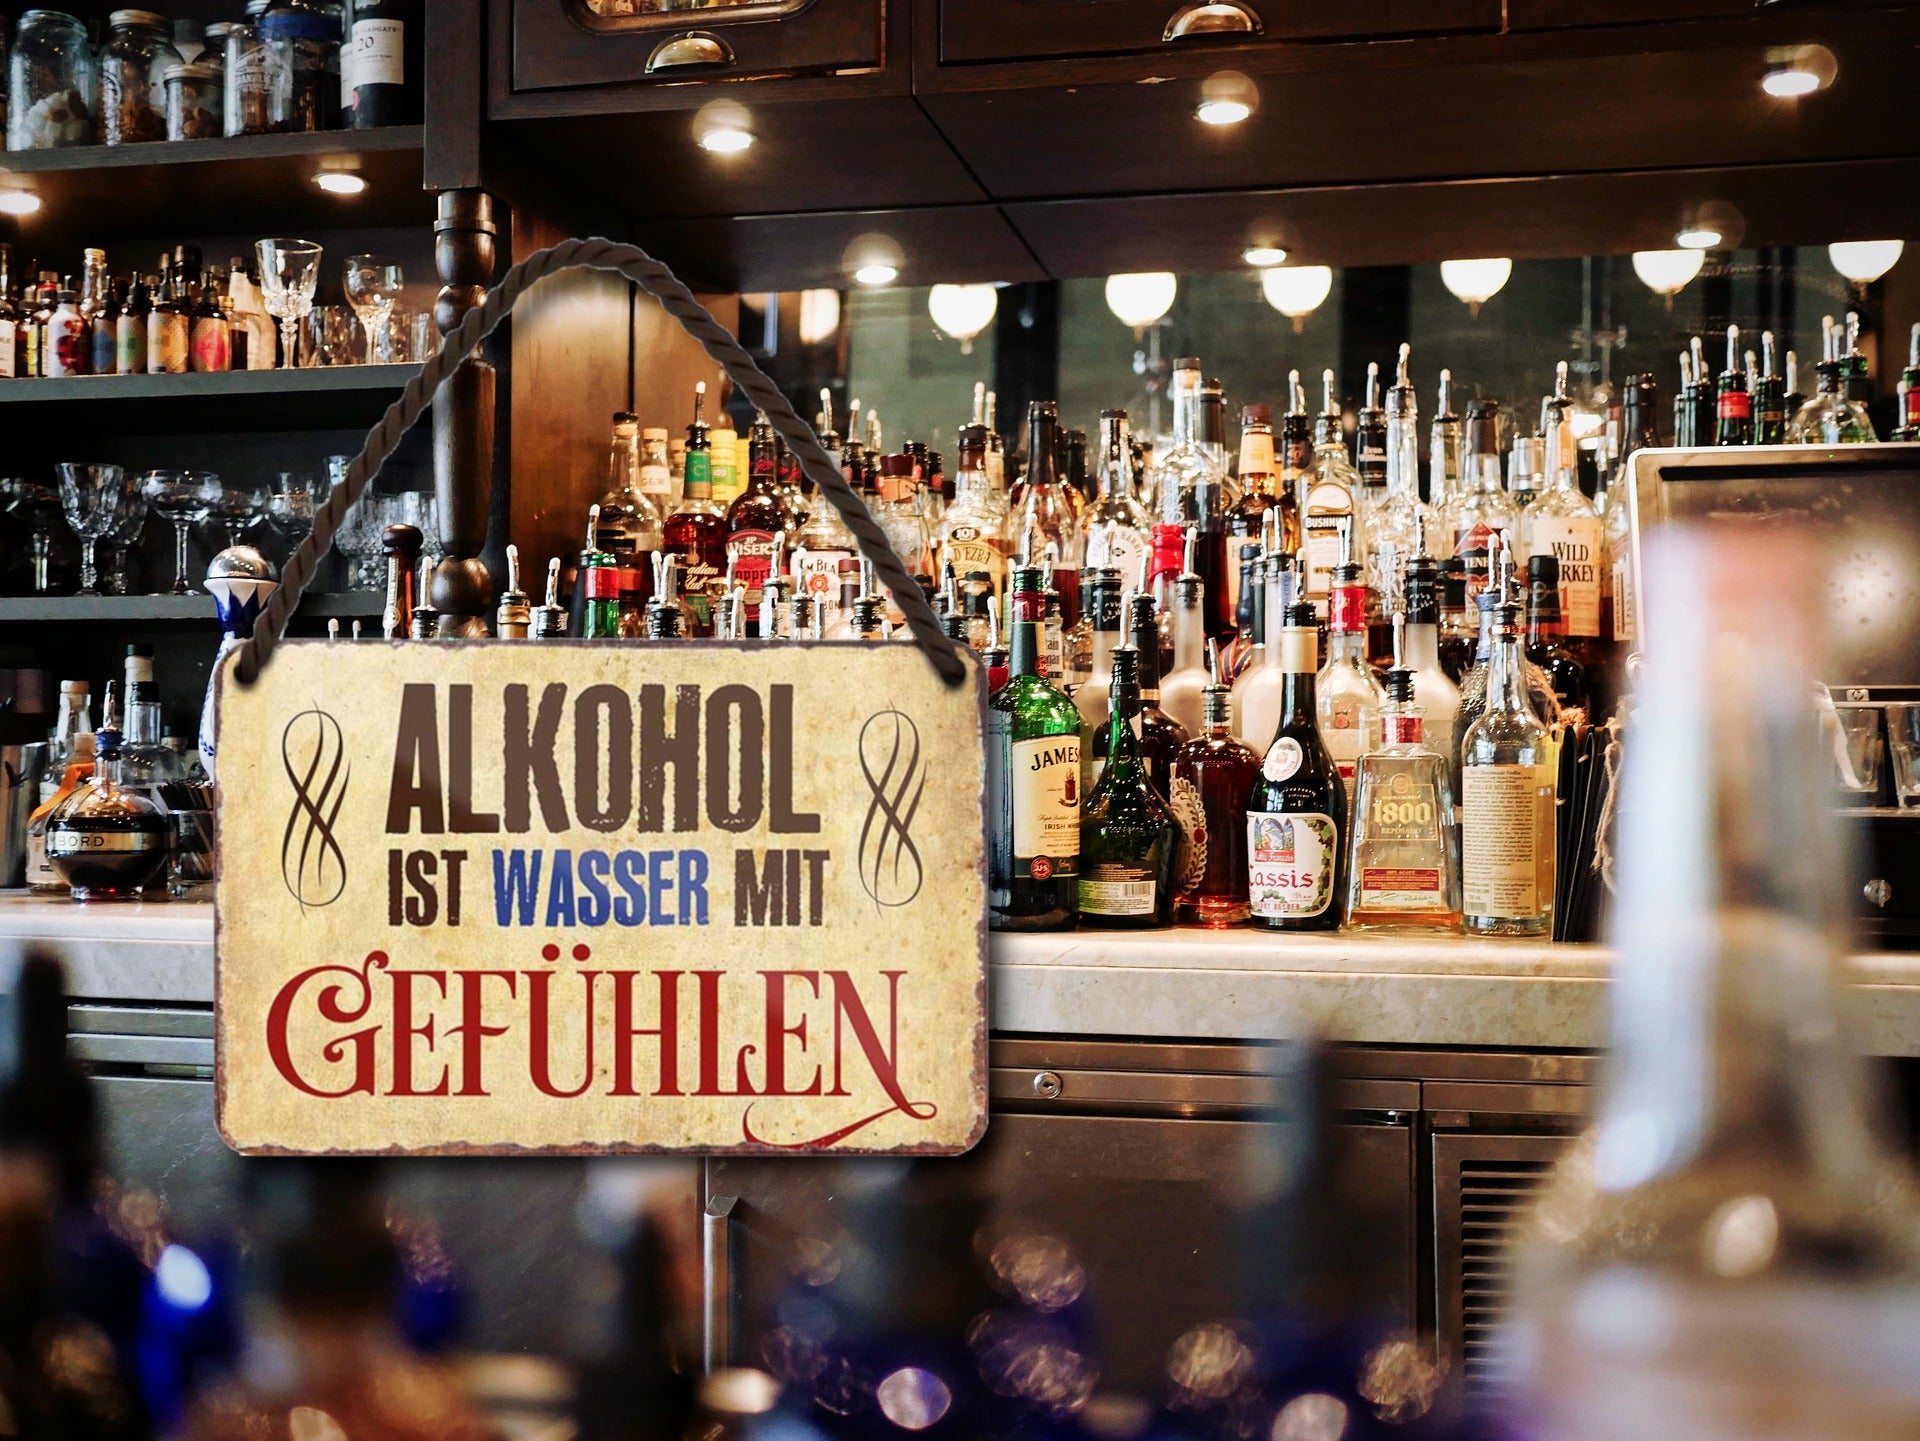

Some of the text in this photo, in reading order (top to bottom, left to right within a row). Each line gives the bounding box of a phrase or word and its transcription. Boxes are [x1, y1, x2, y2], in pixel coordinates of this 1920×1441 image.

[358, 36, 374, 52] 20
[1306, 516, 1338, 528] BUSHMI
[1552, 542, 1589, 562] WILD
[687, 562, 719, 575] adian
[817, 559, 836, 574] BEA
[1561, 564, 1594, 582] RKEY
[385, 682, 821, 834] ALKOHOL
[1031, 746, 1079, 771] JAMES
[1372, 801, 1431, 825] 1800
[388, 849, 830, 927] IST WASSER MIT
[265, 943, 938, 1149] GEFÜHLEN
